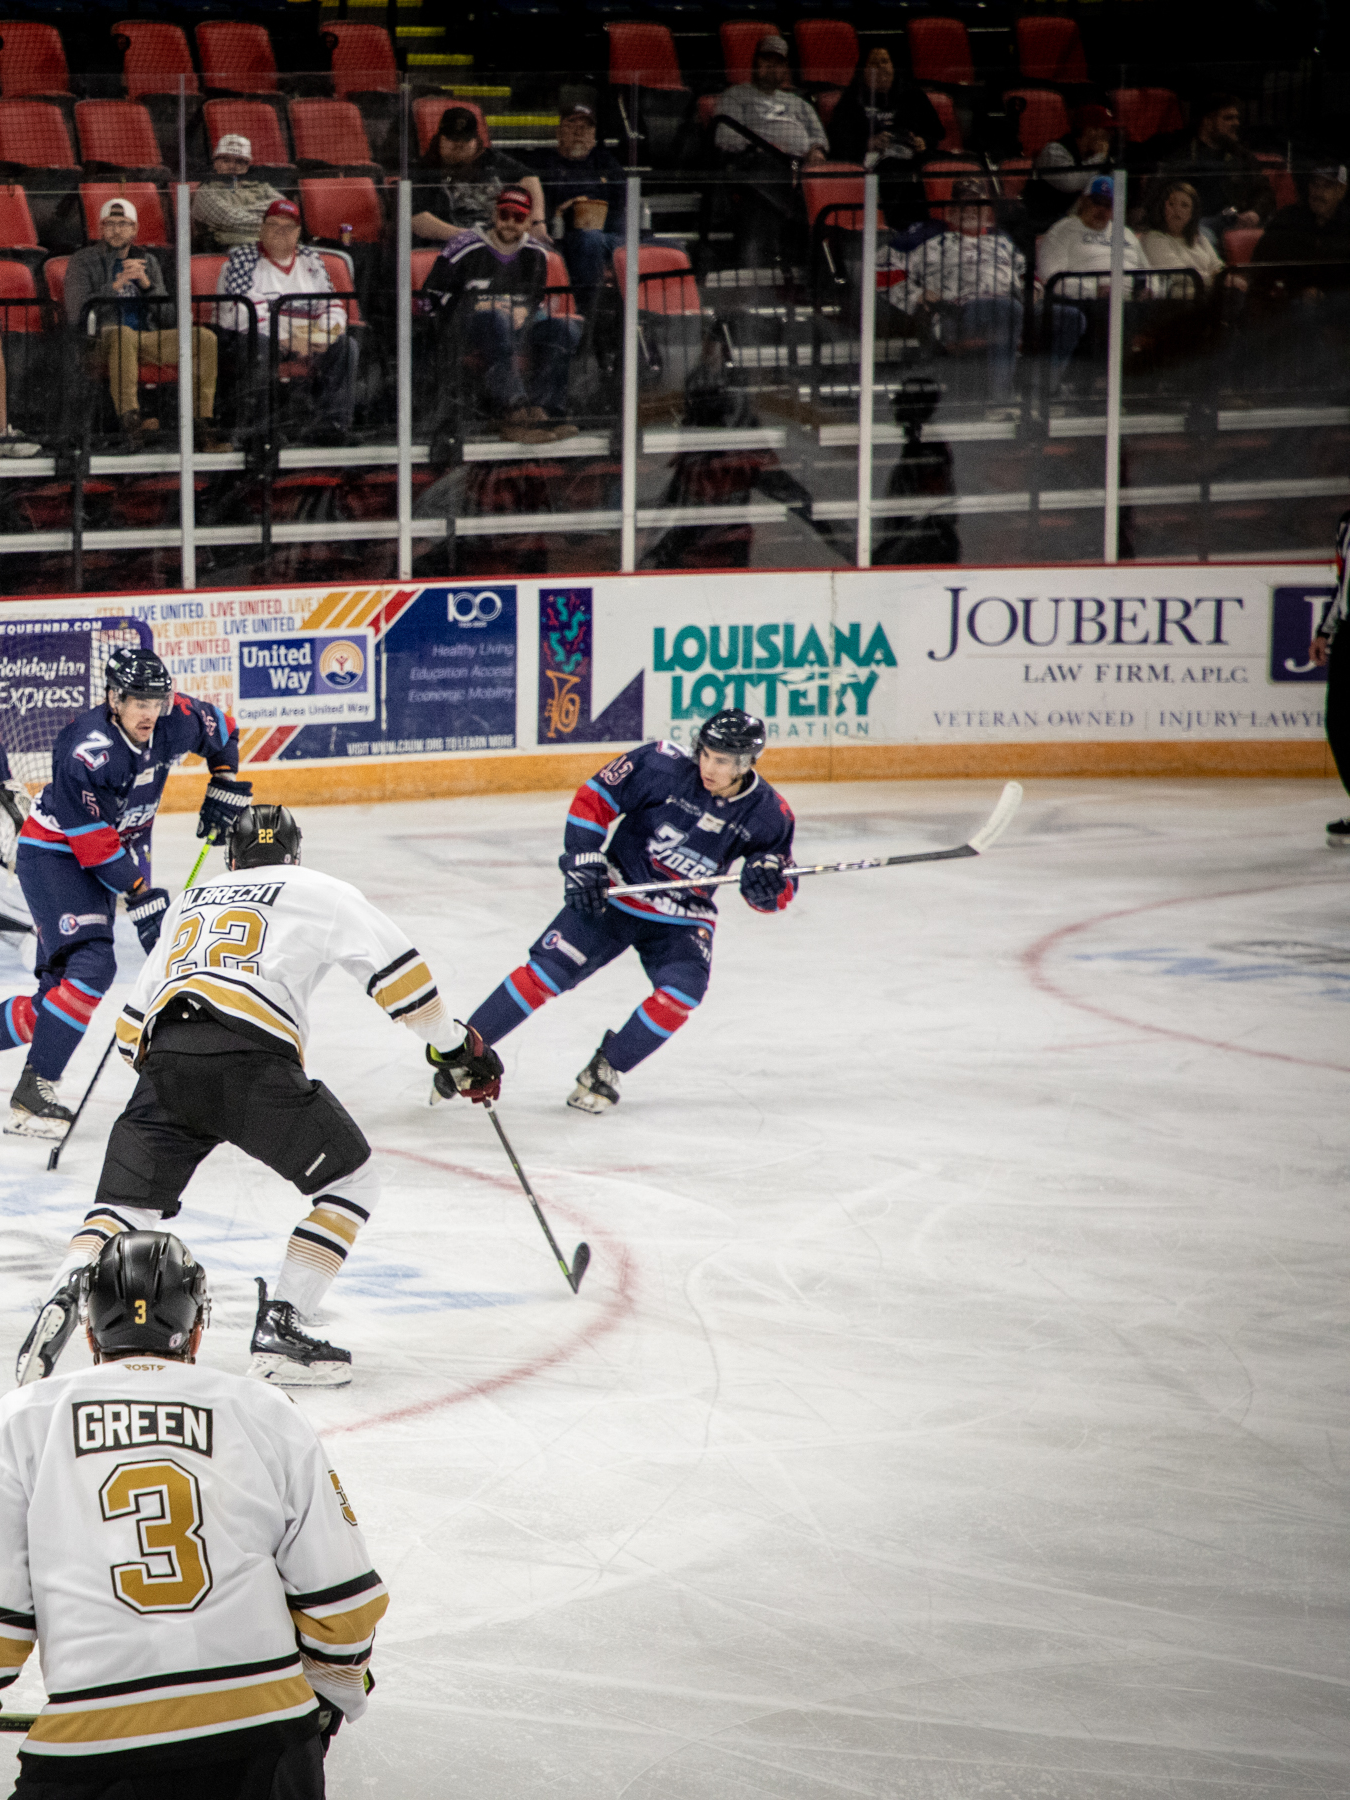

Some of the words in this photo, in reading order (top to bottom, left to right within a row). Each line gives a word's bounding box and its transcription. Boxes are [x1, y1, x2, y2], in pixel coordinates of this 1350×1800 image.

[210, 600, 236, 618] LIVE
[447, 591, 502, 622] 100
[223, 618, 249, 635] LIVE
[927, 586, 1245, 662] JOUBERT
[158, 641, 184, 658] LIVE
[241, 643, 312, 668] United
[432, 643, 475, 659] Healthy
[479, 643, 515, 658] Living
[653, 622, 898, 672] LOUISIANA
[171, 658, 196, 675] LIVE
[1023, 664, 1084, 684] LAW
[183, 677, 209, 692] LIVE
[268, 667, 312, 694] Way
[671, 669, 881, 720] LOTTERY
[238, 705, 277, 721] Capital
[281, 706, 306, 718] Area
[309, 703, 345, 716] United
[348, 702, 371, 715] Way
[934, 711, 1038, 729] VETERAN
[1048, 710, 1135, 728] OWNED
[1159, 710, 1239, 731] INJURY
[670, 721, 870, 738] CORATION
[258, 828, 274, 844] 22
[165, 906, 269, 977] 22
[134, 1298, 147, 1325] 3
[76, 1403, 208, 1453] GREEN
[99, 1458, 214, 1615] 3
